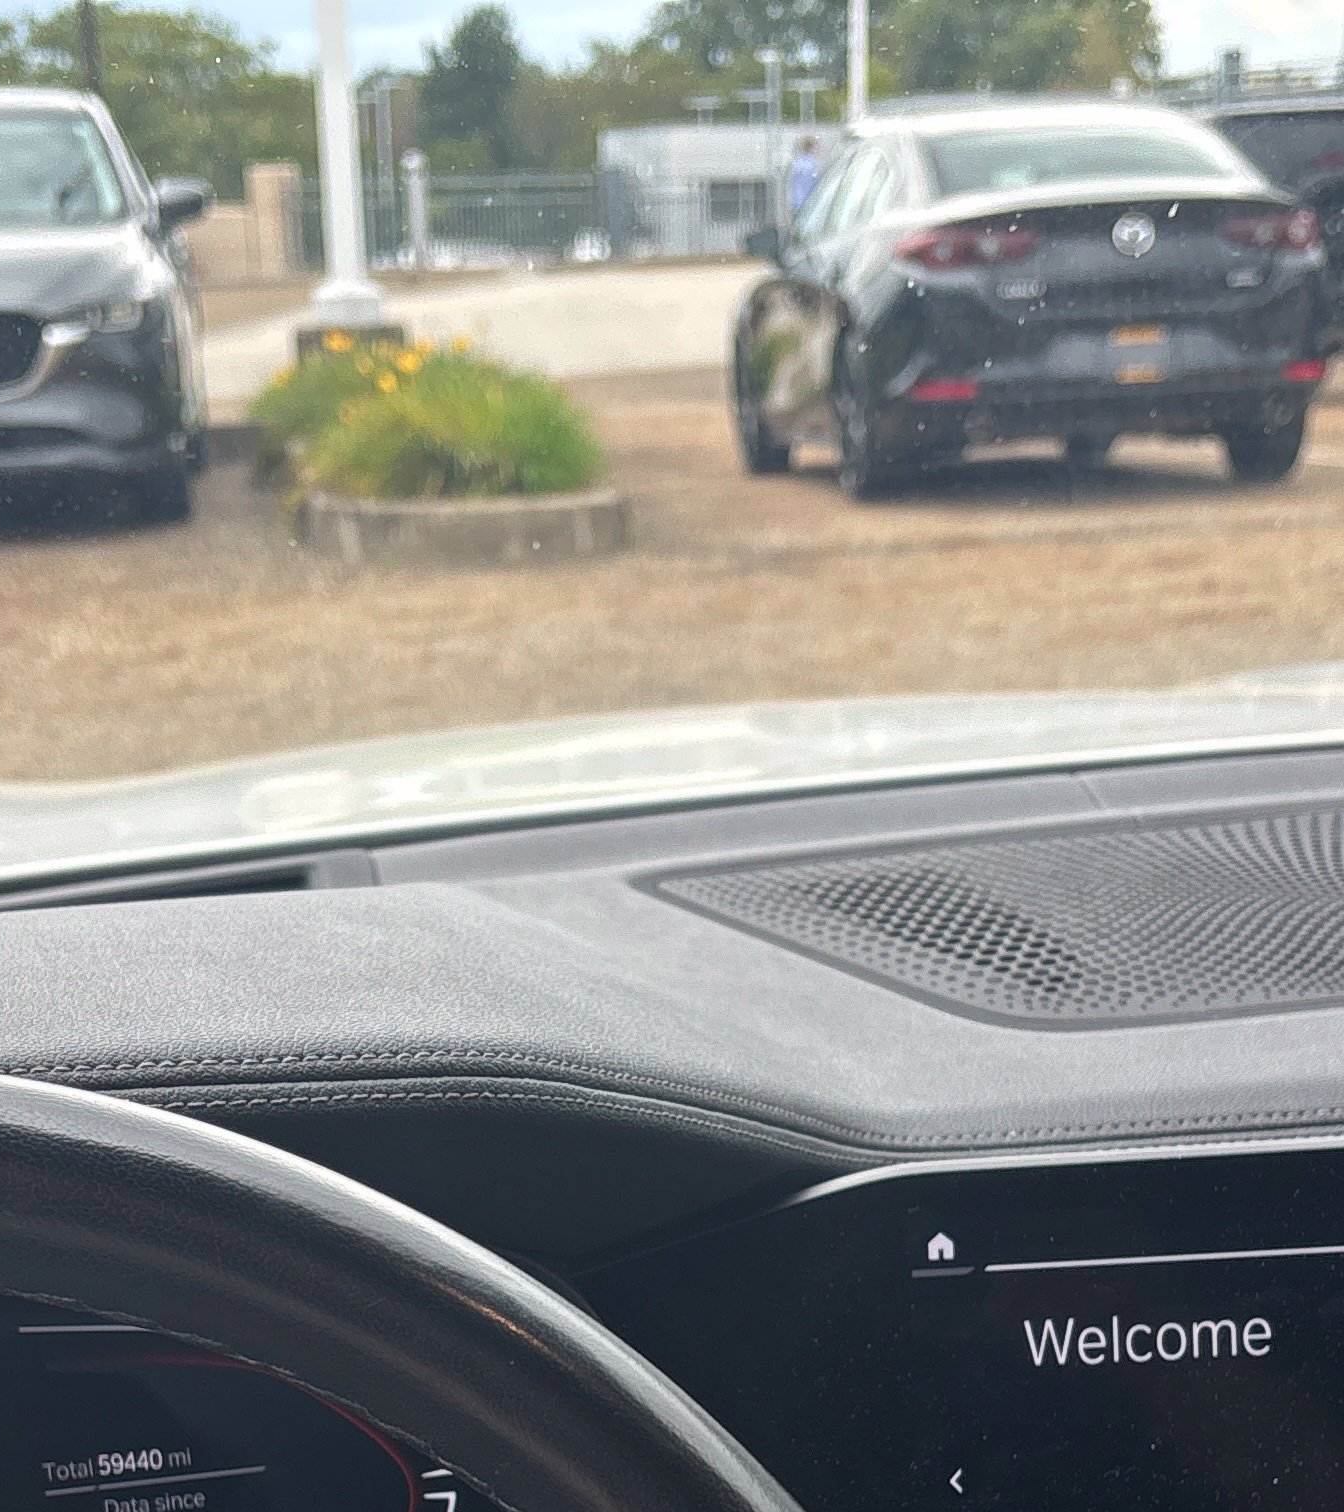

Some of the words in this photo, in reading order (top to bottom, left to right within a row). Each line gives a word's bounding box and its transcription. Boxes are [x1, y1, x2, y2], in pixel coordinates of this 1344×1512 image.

[1022, 1315, 1273, 1367] Welcome
[42, 1460, 94, 1483] Total
[97, 1448, 163, 1476] 59440
[168, 1447, 192, 1467] mi
[154, 1489, 206, 1512] since
